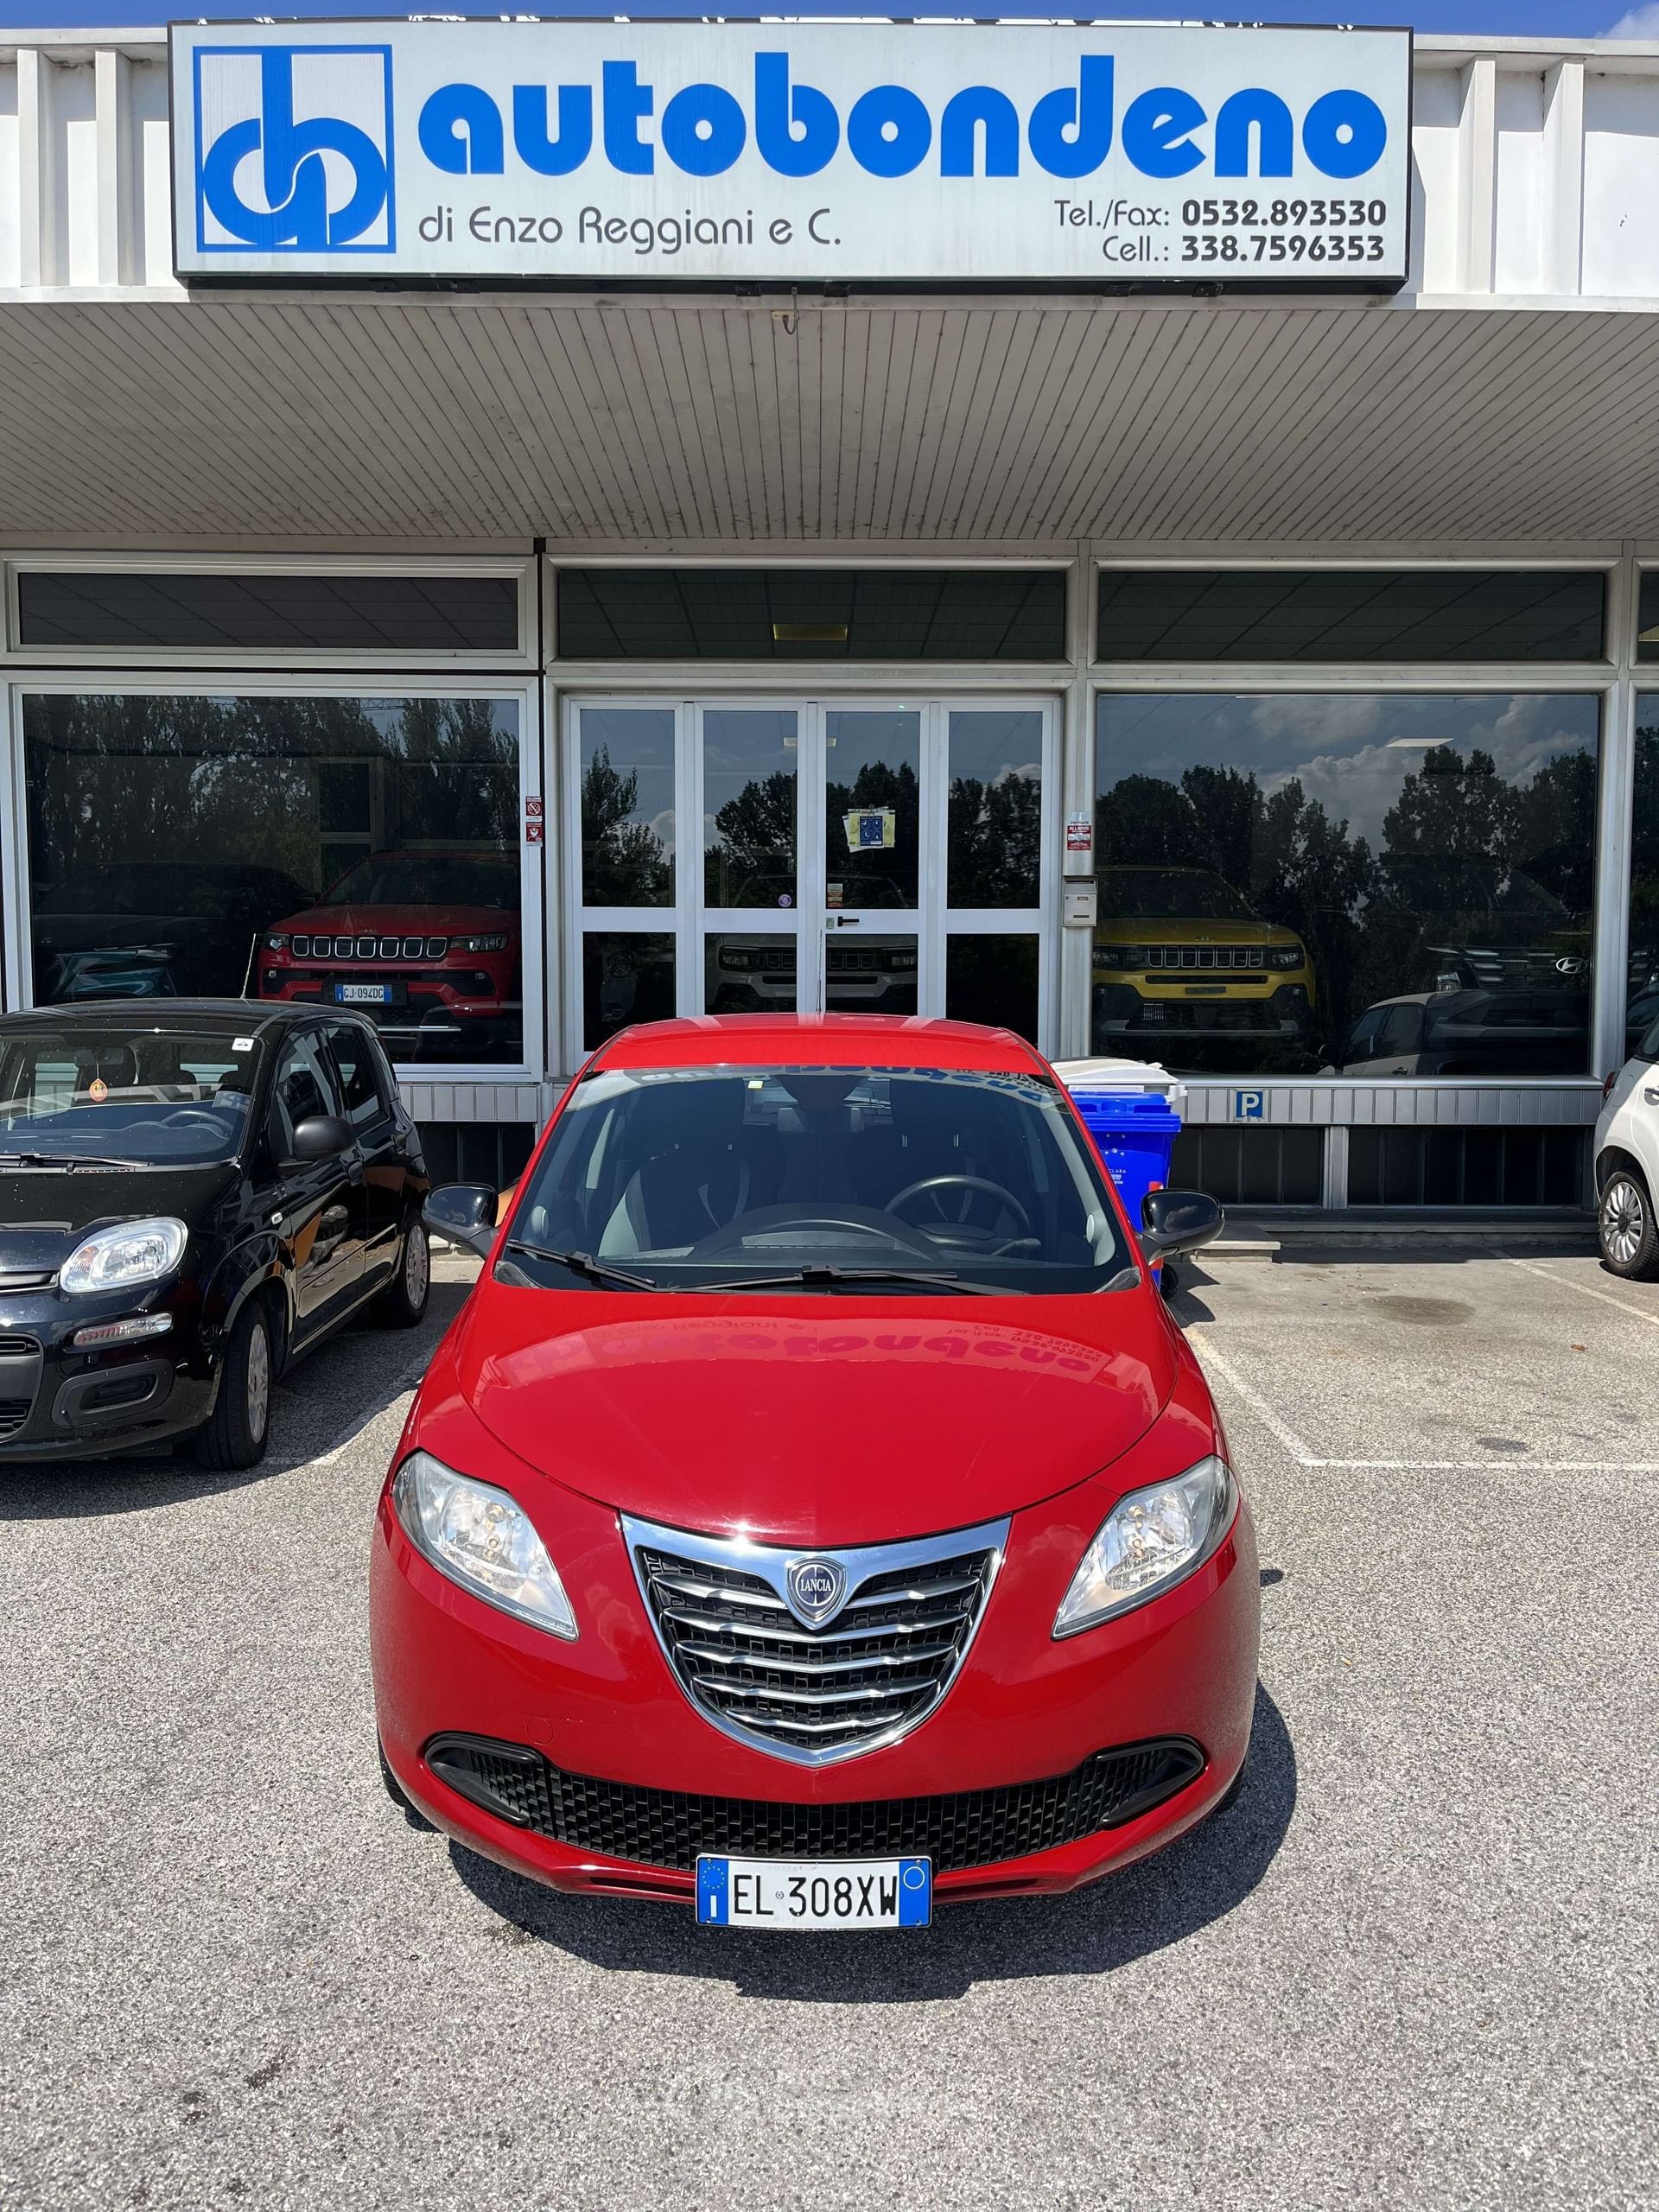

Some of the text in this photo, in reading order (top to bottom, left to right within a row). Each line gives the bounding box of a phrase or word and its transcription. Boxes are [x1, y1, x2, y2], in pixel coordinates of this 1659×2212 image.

[418, 52, 1387, 179] autobondeno
[1054, 199, 1387, 230] Tel./Fax: 0532.893530
[418, 206, 841, 255] di Enzo Reggiani e C.
[1103, 235, 1384, 262] Cell.: 338.7596353
[1242, 1093, 1259, 1116] P
[801, 1579, 831, 1591] LANCIA
[734, 1873, 898, 1917] EL 308XW
